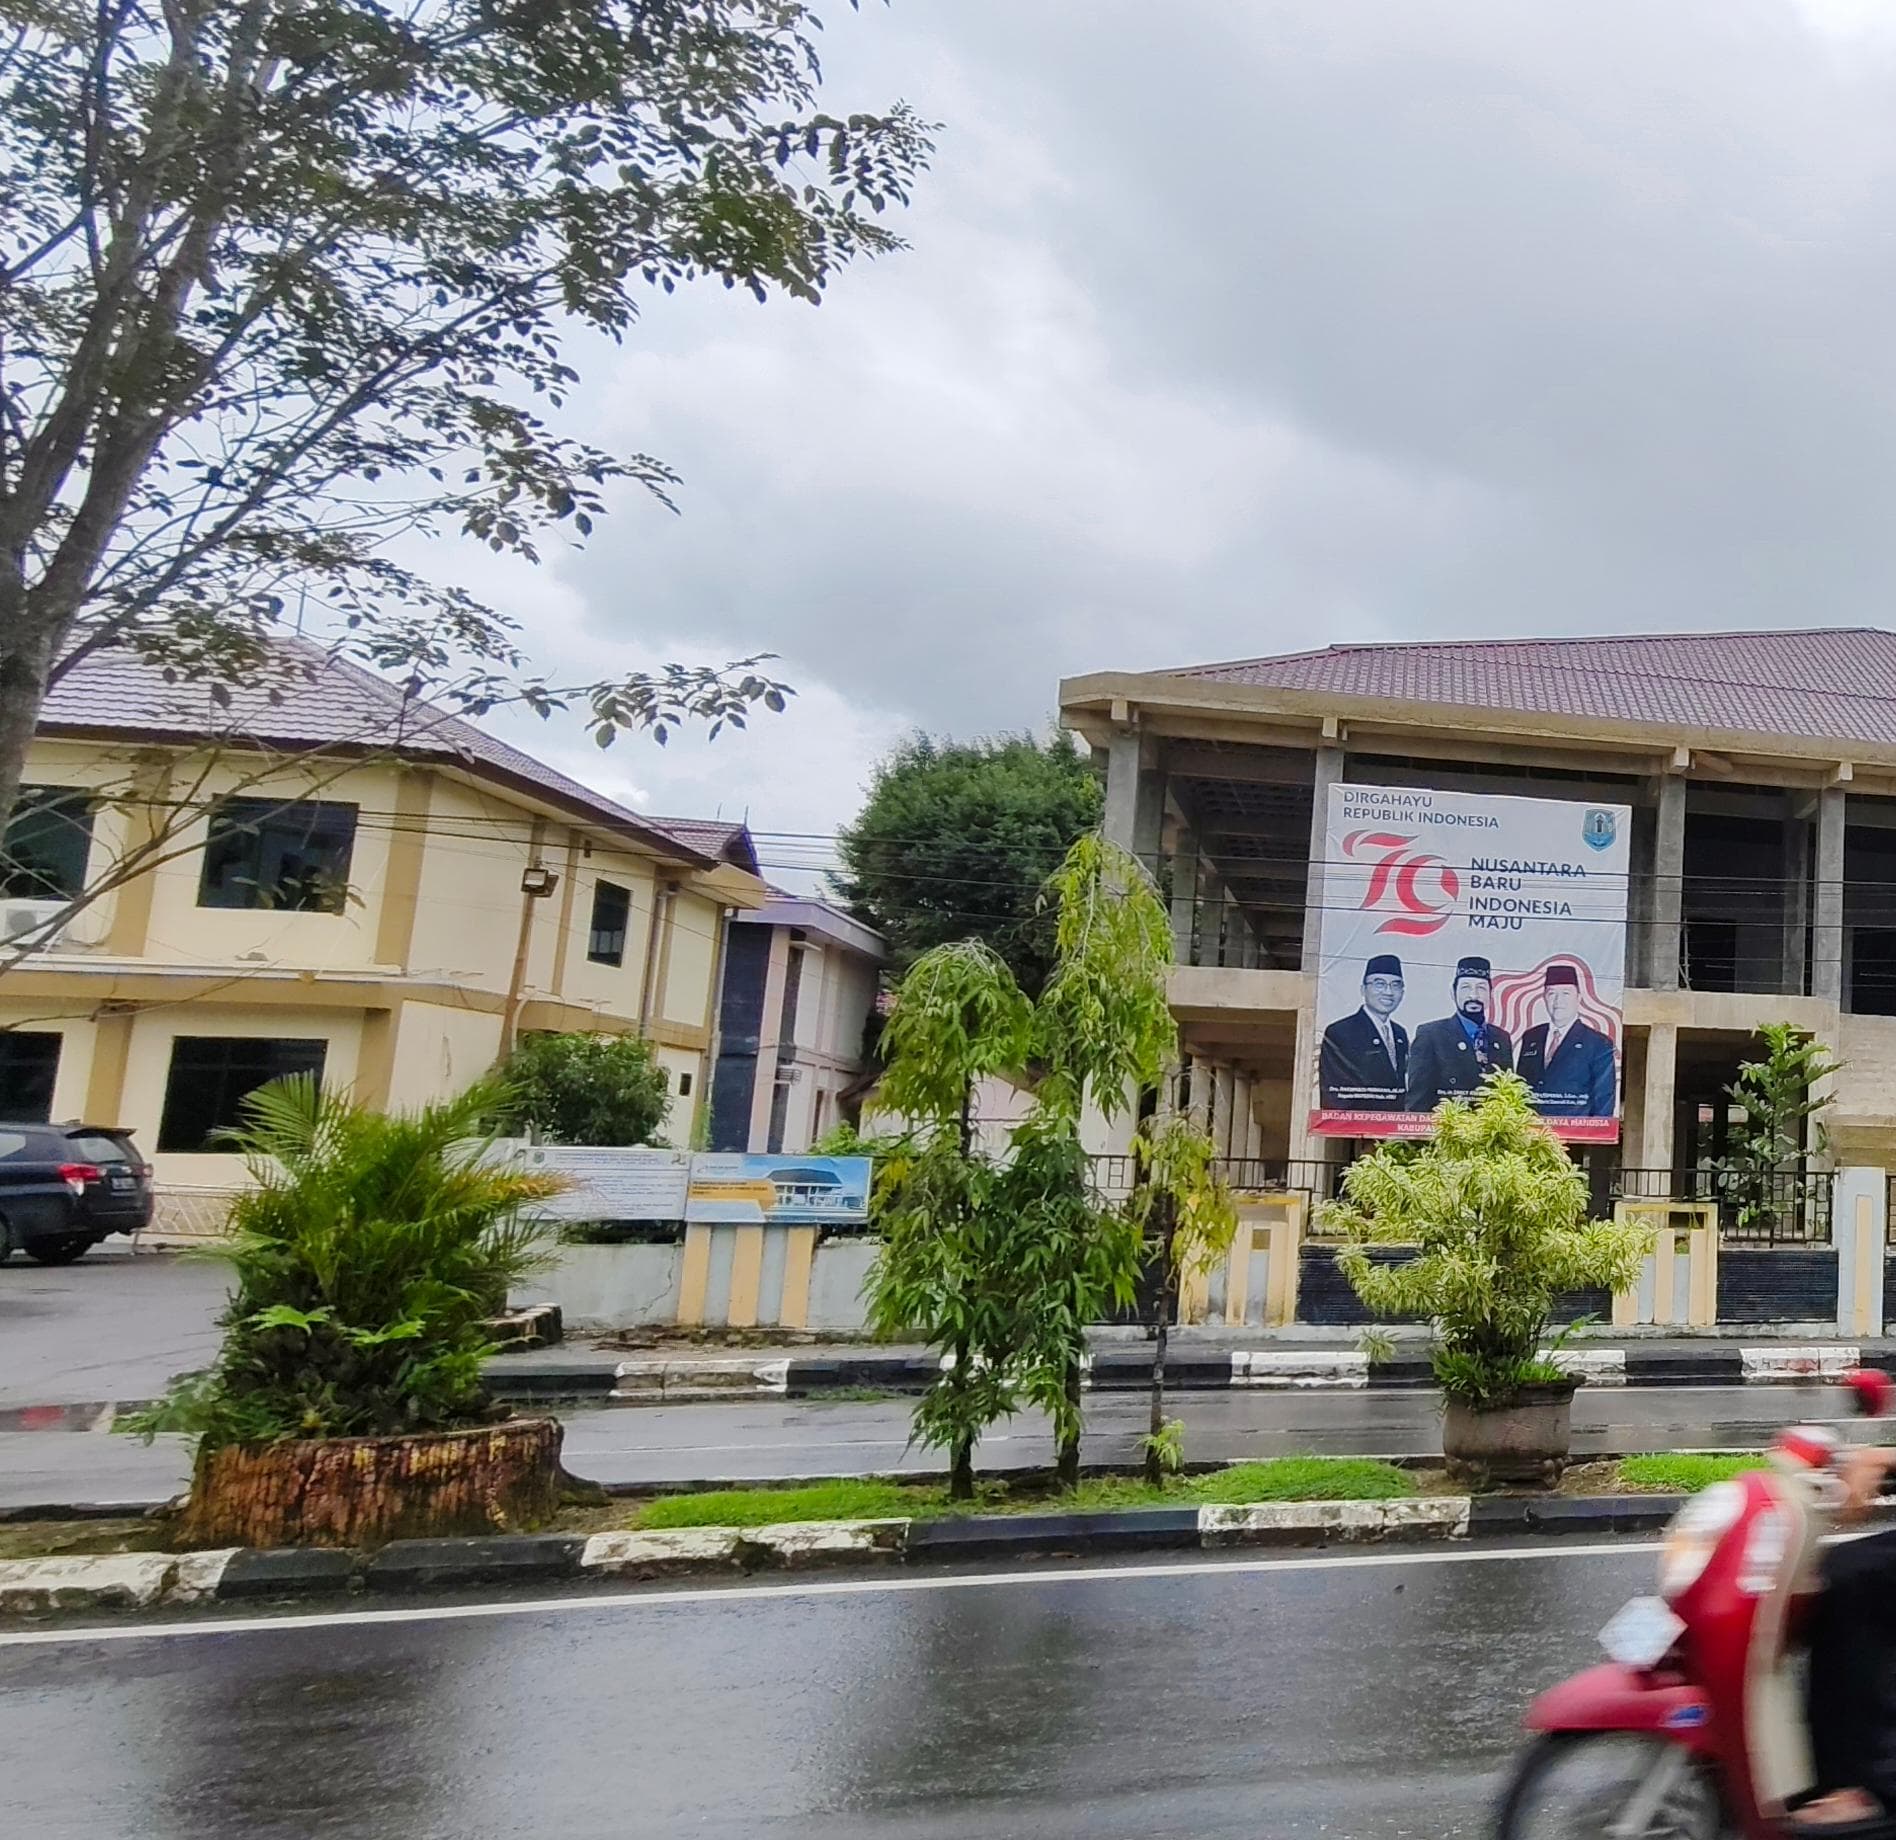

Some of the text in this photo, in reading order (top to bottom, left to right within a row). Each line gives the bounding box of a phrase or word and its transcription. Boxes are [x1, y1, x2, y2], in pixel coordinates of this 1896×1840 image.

[1343, 791, 1432, 808] DIRGAHAYU
[1343, 806, 1499, 828] REPUBLIK INDONESIA
[1471, 857, 1586, 878] NUSANTARA
[1342, 829, 1460, 936] 79
[1470, 875, 1522, 892] BARU
[1469, 896, 1573, 916] INDONESIA
[1468, 913, 1523, 930] MAJU
[1321, 1111, 1353, 1121] BADAN
